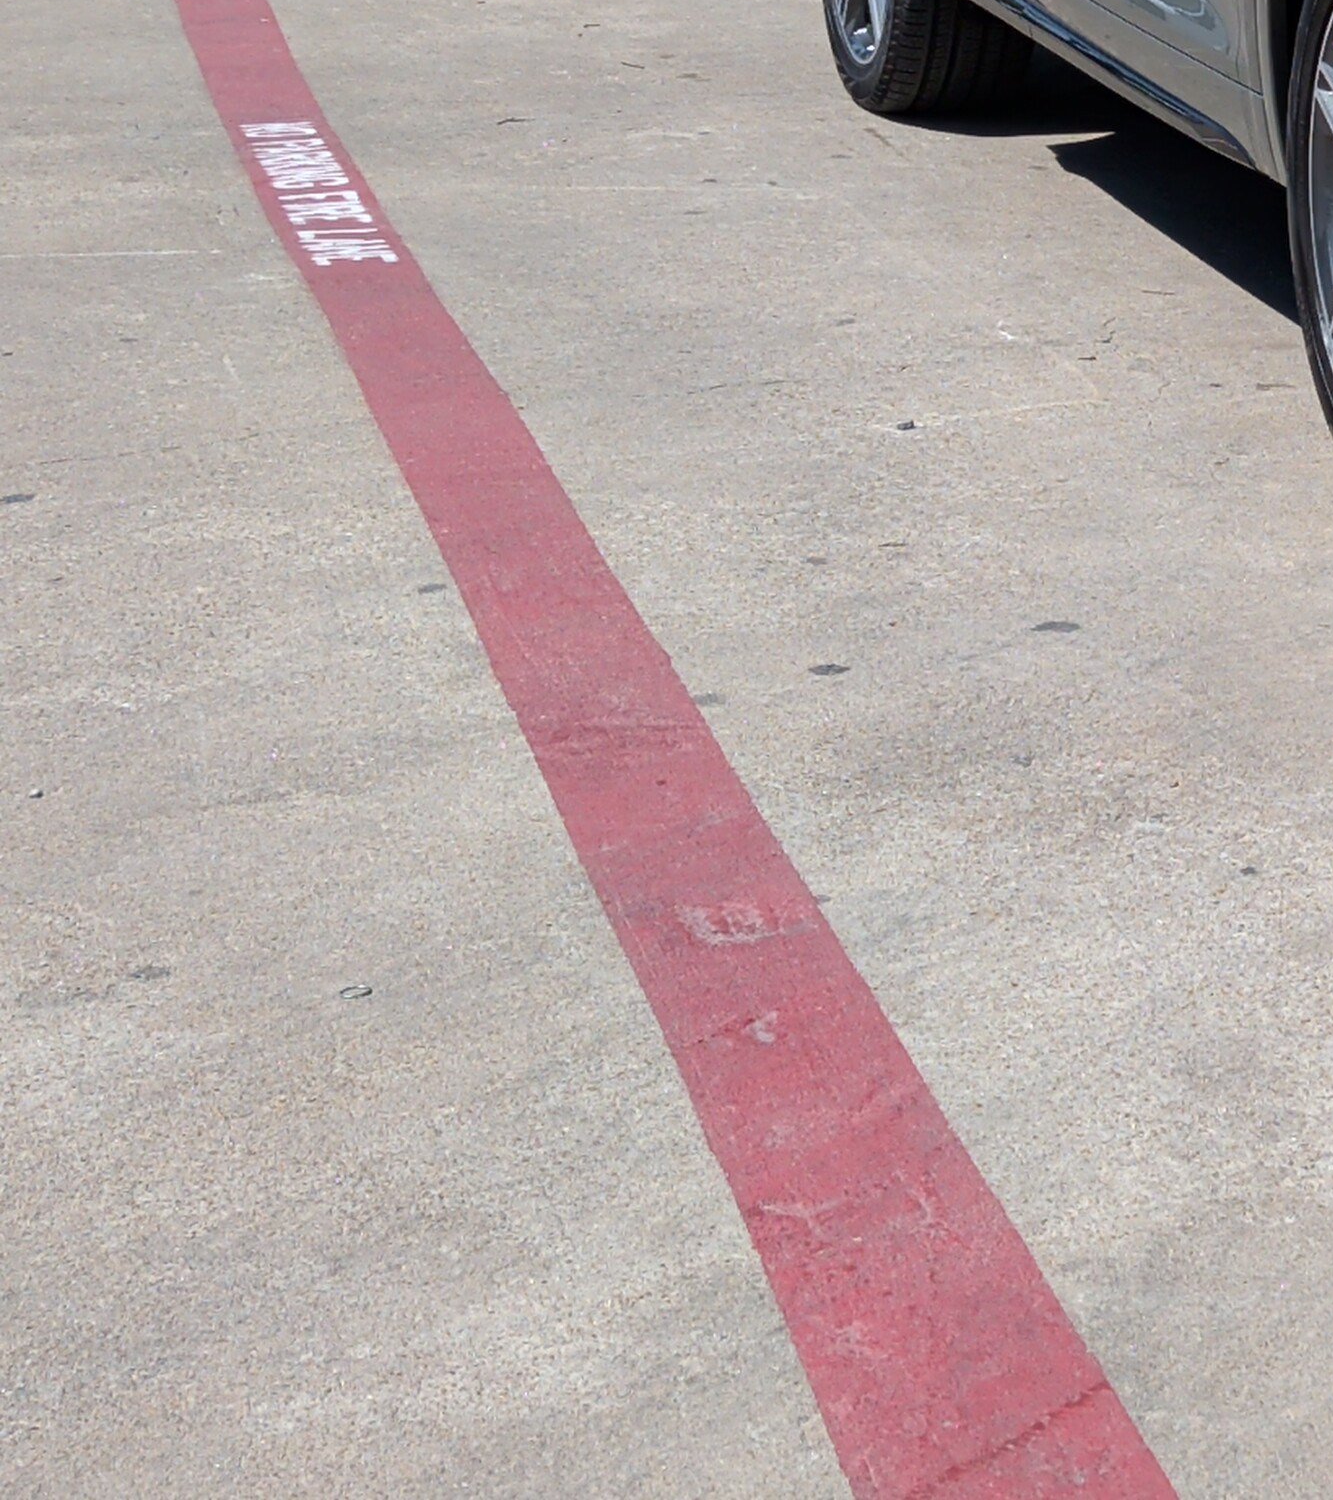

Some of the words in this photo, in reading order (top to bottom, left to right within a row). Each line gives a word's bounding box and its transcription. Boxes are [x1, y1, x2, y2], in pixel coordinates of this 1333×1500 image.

[238, 121, 318, 138] NO
[249, 138, 350, 189] PARKING
[277, 190, 373, 225] FIRE
[296, 228, 399, 266] LANE
